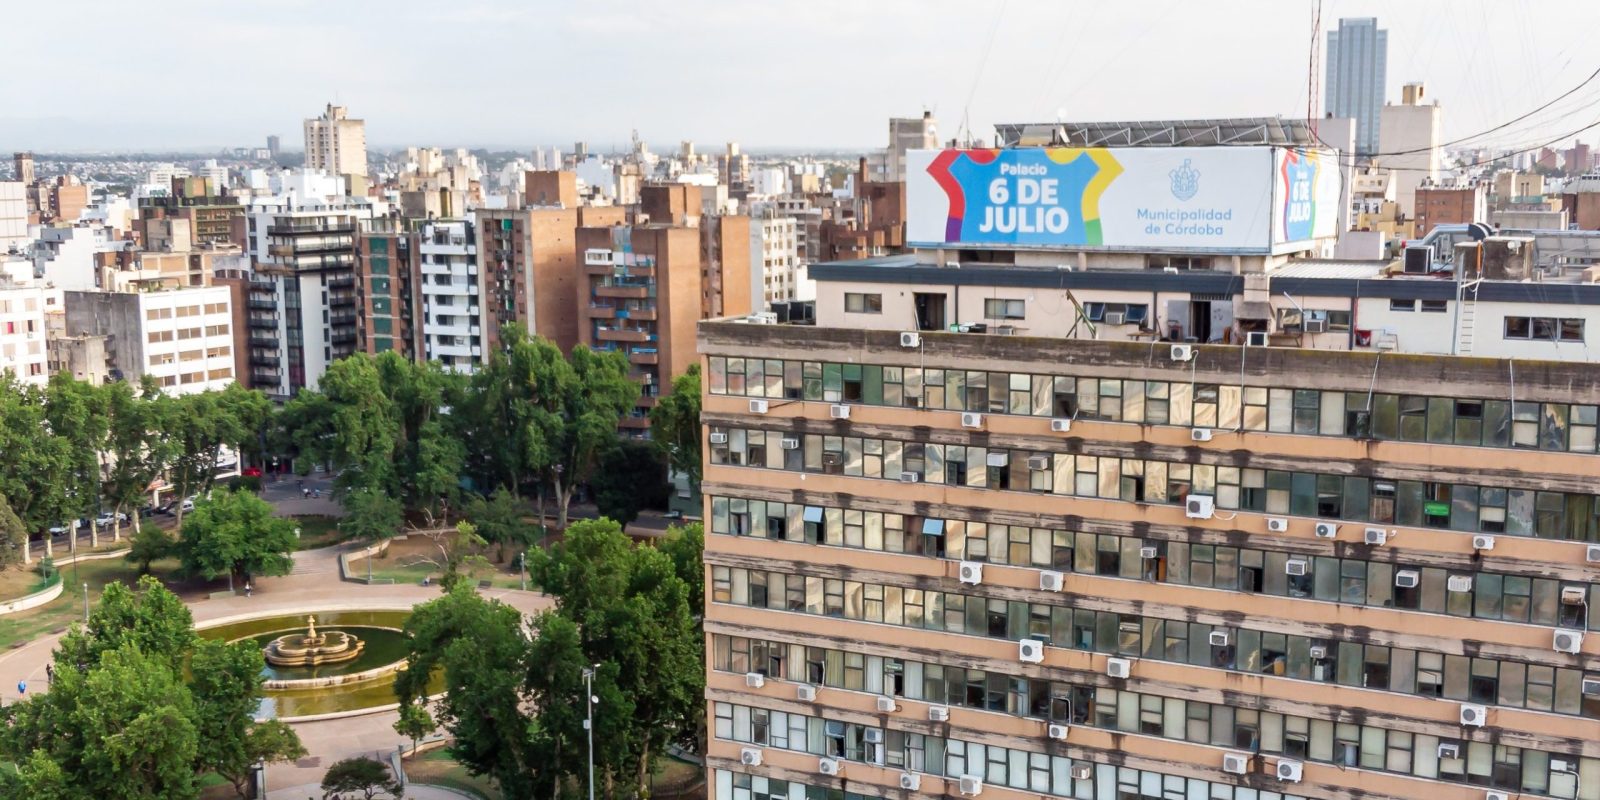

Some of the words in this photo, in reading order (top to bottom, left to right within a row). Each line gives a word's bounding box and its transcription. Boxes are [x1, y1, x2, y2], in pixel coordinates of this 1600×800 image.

[1000, 162, 1047, 175] Palacio
[989, 178, 1009, 205] 6
[1017, 178, 1058, 205] DE
[1293, 181, 1299, 202] 6
[1300, 181, 1310, 201] DE
[979, 206, 1069, 234] JULIO
[1136, 208, 1232, 223] Municipalidad
[1289, 202, 1311, 223] JULIO
[1145, 223, 1160, 234] de
[1165, 223, 1223, 235] Córdoba
